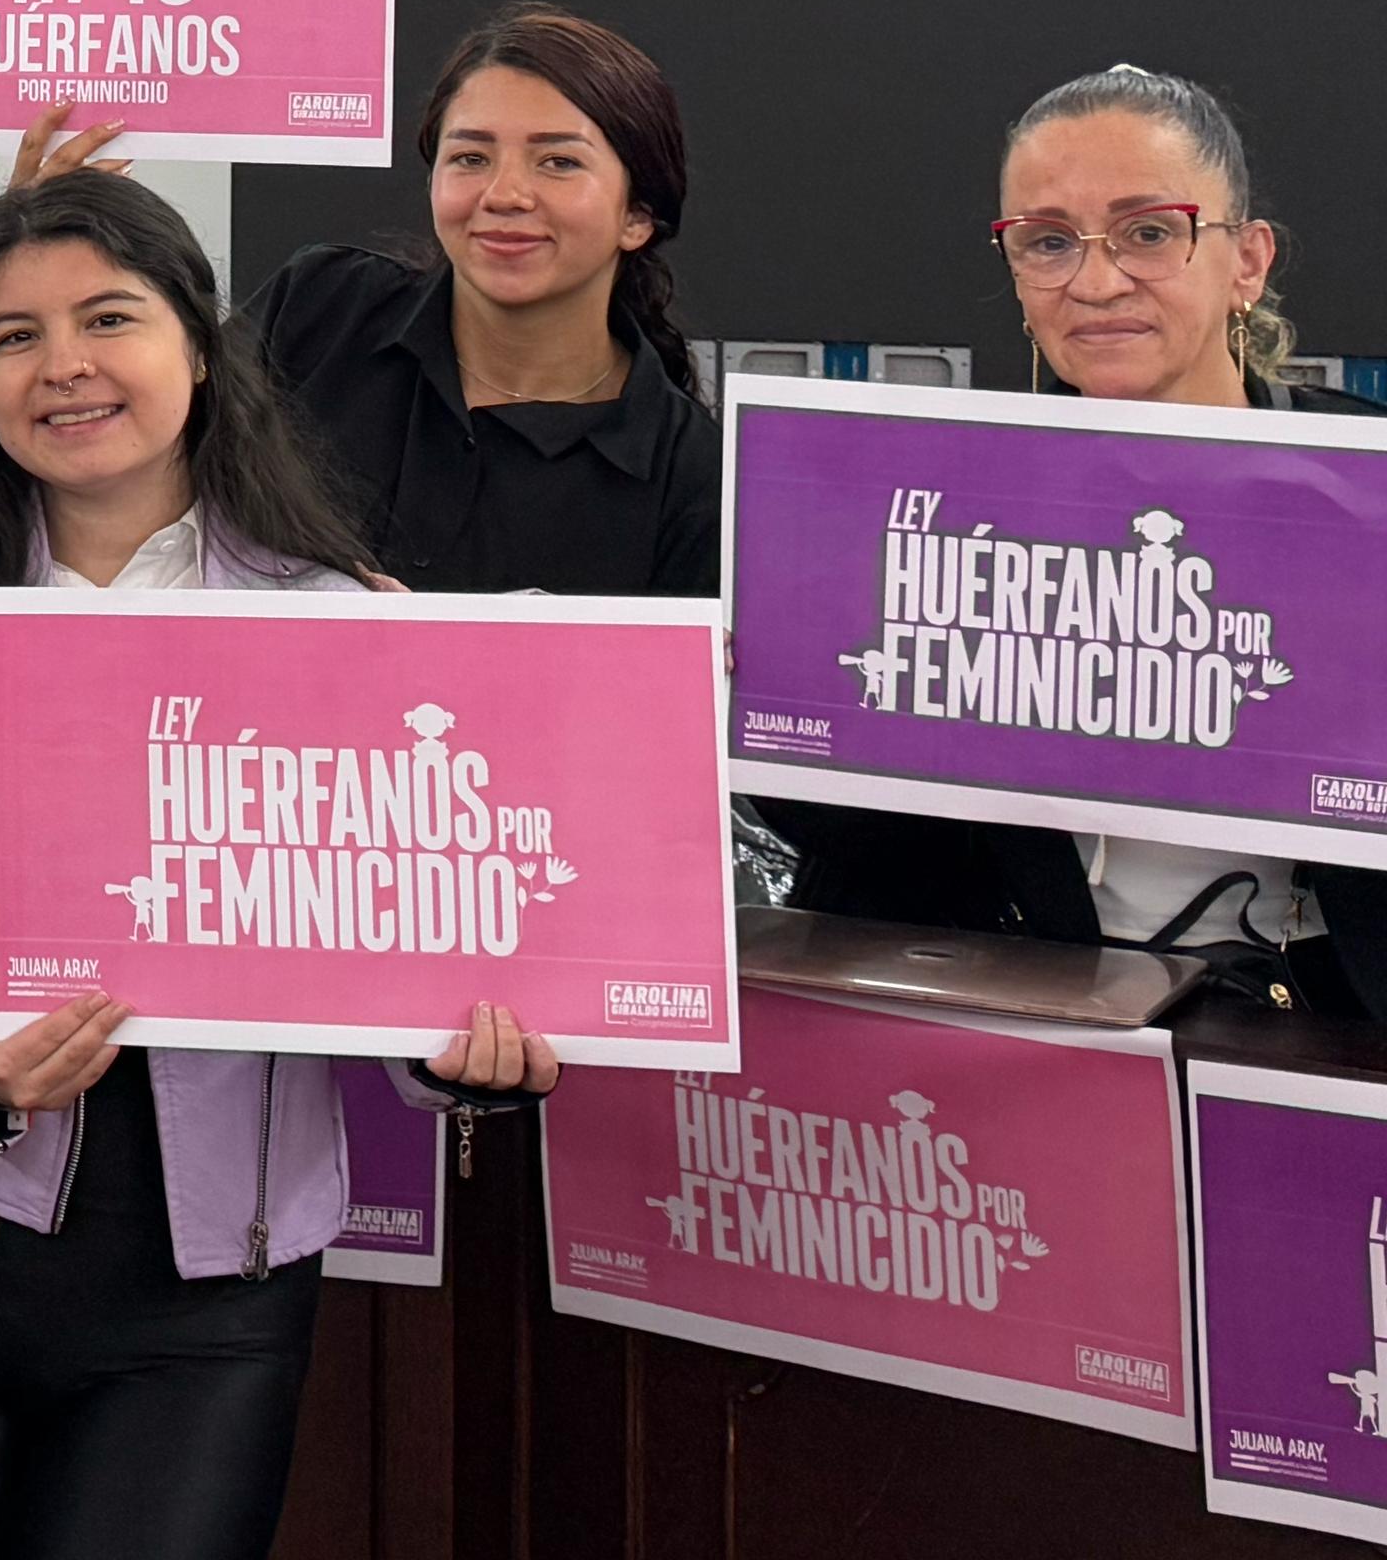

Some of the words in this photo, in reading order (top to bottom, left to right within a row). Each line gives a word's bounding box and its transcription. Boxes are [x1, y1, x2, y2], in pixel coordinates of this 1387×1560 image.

[18, 78, 51, 102] POR
[55, 78, 168, 104] FEMINICIDIO
[292, 95, 367, 111] CAROLINA
[888, 488, 943, 532] LEY
[883, 524, 1213, 651] HUÉRFANOS
[1217, 609, 1272, 658] POR
[882, 622, 1236, 747] FEMINICIDIO
[148, 695, 202, 742] LEY
[745, 711, 794, 734] JULIANA
[796, 718, 832, 738] ARAY.
[146, 728, 490, 853] HUÉRFANOS
[497, 806, 553, 854] POR
[1316, 778, 1387, 803] CAROLI
[1316, 796, 1364, 812] GIRALDO
[148, 843, 520, 957] FEMINICIDIO
[8, 957, 60, 978] JULIANA
[63, 958, 102, 980] ARAY.
[609, 985, 707, 1008] CAROLINA
[675, 1087, 972, 1221] HUÉRFANOS
[976, 1180, 1027, 1230] POR
[346, 1207, 418, 1228] AROLINA
[680, 1171, 998, 1312] FEMINICIDIO
[1080, 1349, 1165, 1382] CAROLINA
[1230, 1429, 1285, 1456] JULIANA
[1288, 1439, 1328, 1463] ARAY.
